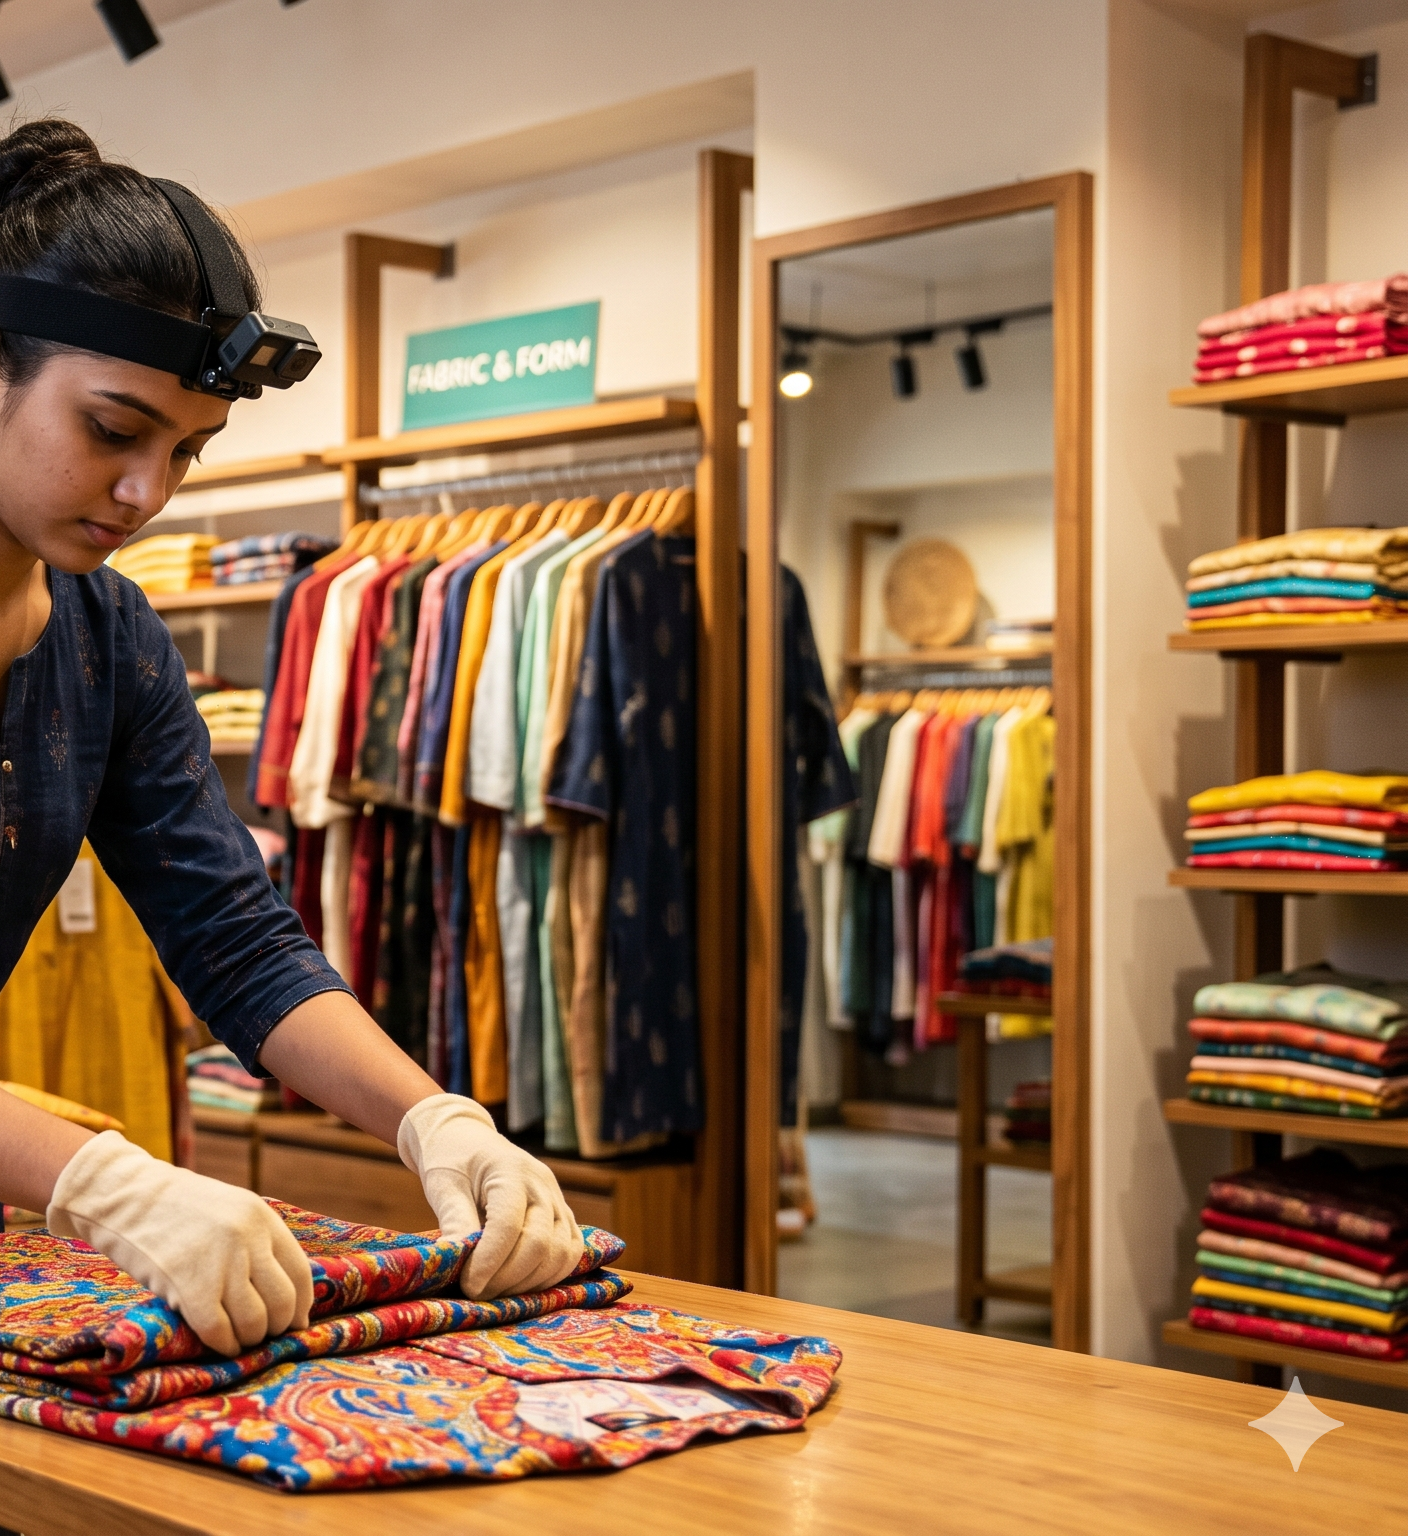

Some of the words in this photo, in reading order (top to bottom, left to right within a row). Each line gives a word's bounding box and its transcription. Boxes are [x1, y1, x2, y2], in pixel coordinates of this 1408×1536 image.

[407, 352, 491, 395] FABRIC
[493, 350, 513, 382] &
[516, 335, 591, 378] FORM
